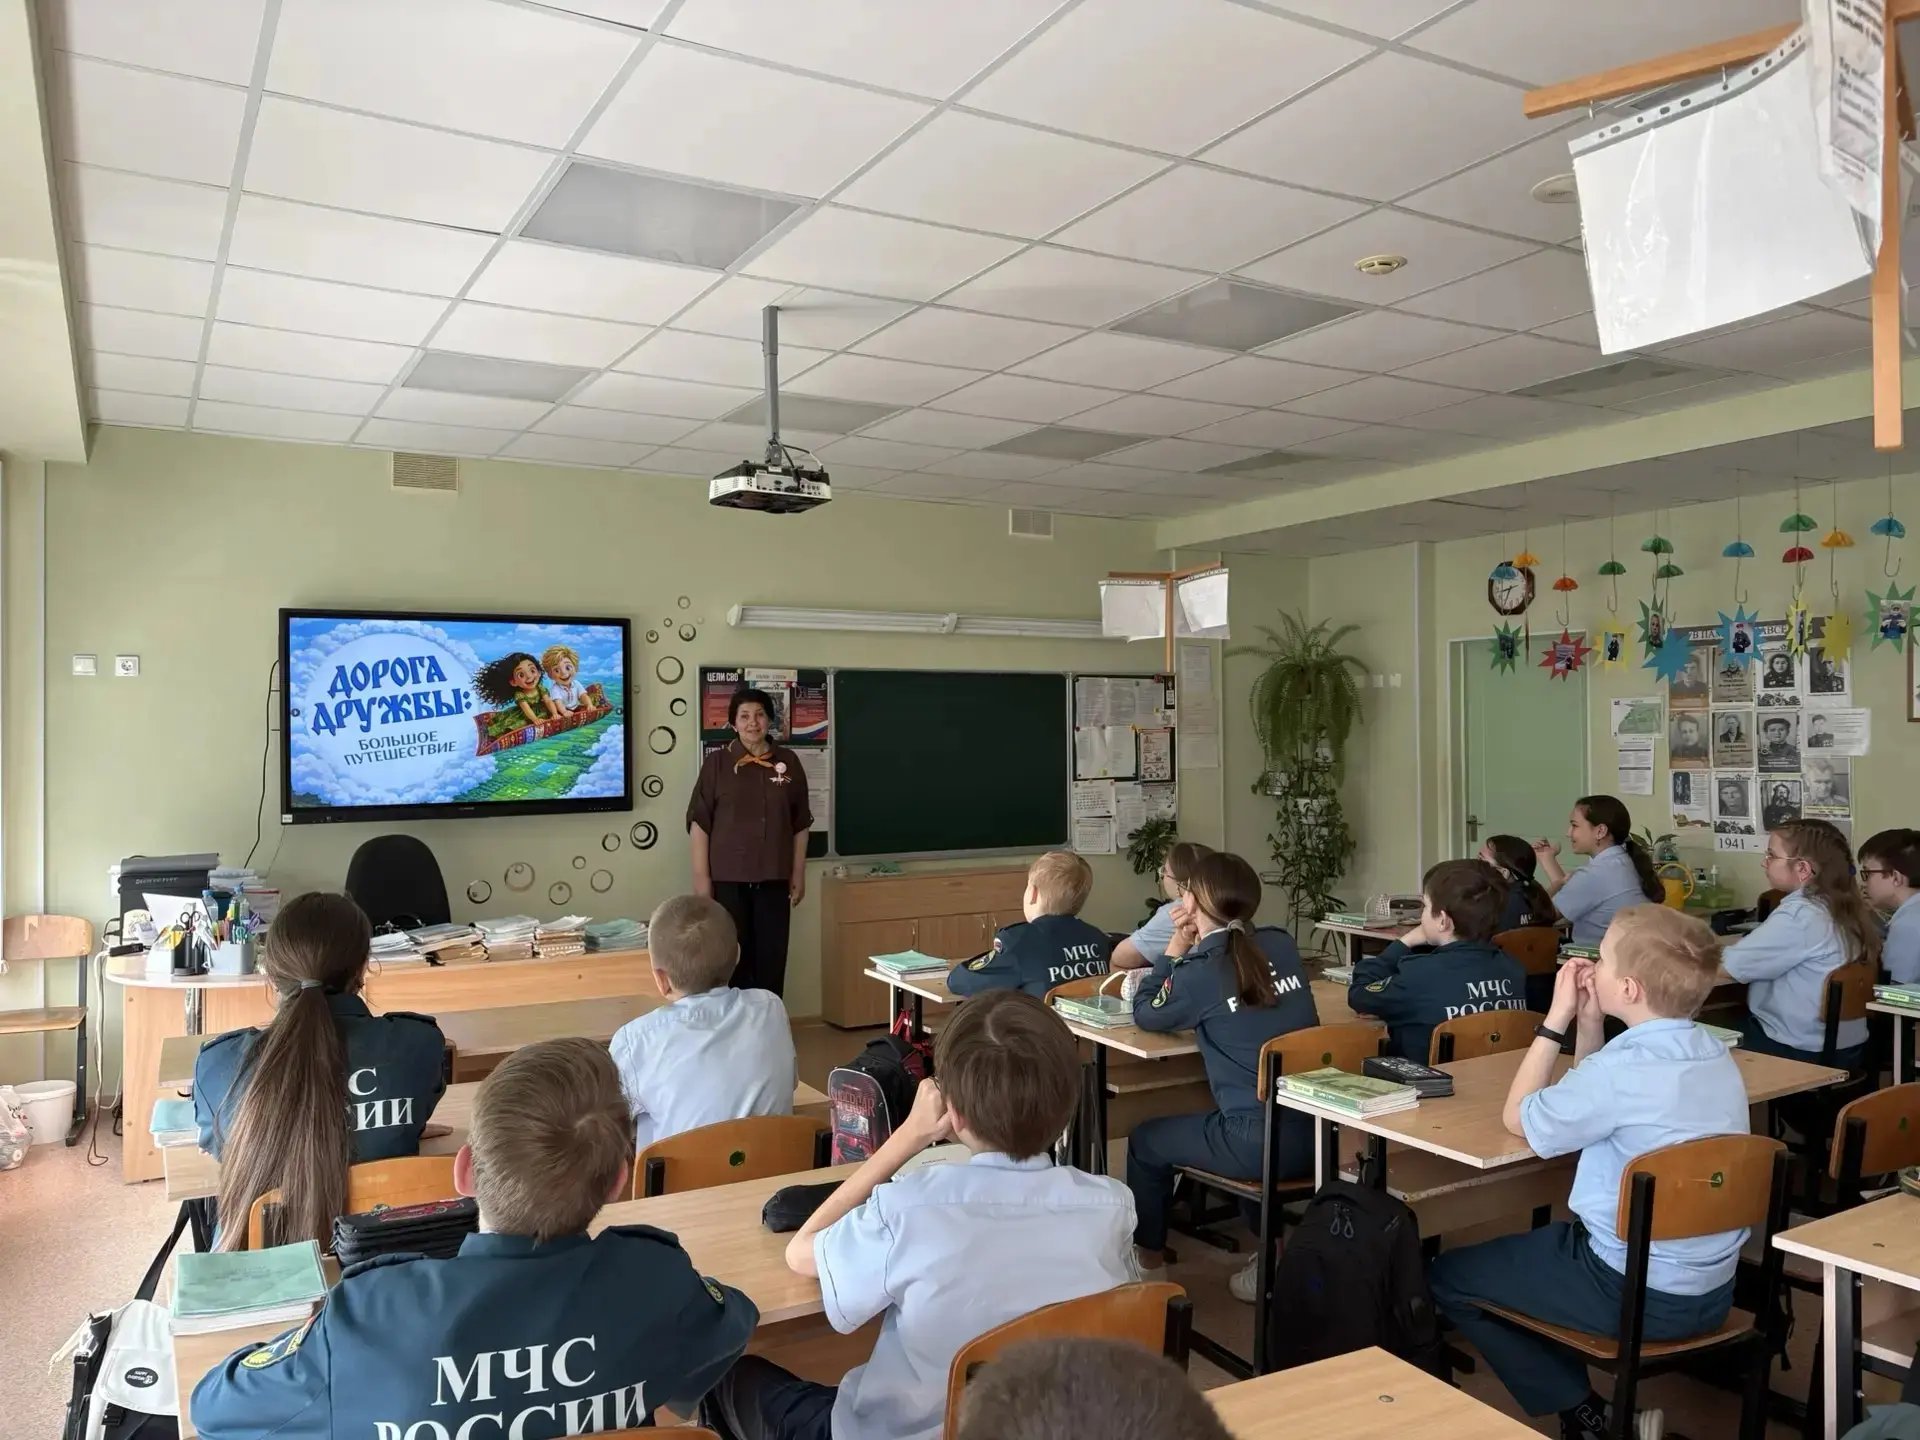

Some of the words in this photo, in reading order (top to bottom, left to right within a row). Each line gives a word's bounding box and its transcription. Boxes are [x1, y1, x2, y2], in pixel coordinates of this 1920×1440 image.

[327, 655, 447, 699] ДОРОГА
[707, 672, 726, 682] ЦЕЛИ
[726, 672, 739, 682] СВО
[312, 688, 472, 736] ДРУЖБЫ:
[358, 731, 438, 751] БОЛЬШОЕ
[344, 741, 456, 765] ПУТЕШЕСТВИЕ
[1719, 838, 1745, 849] 1941
[1062, 943, 1099, 961] МЧС
[1465, 979, 1513, 999] МЧС
[430, 1334, 597, 1406] МЧС
